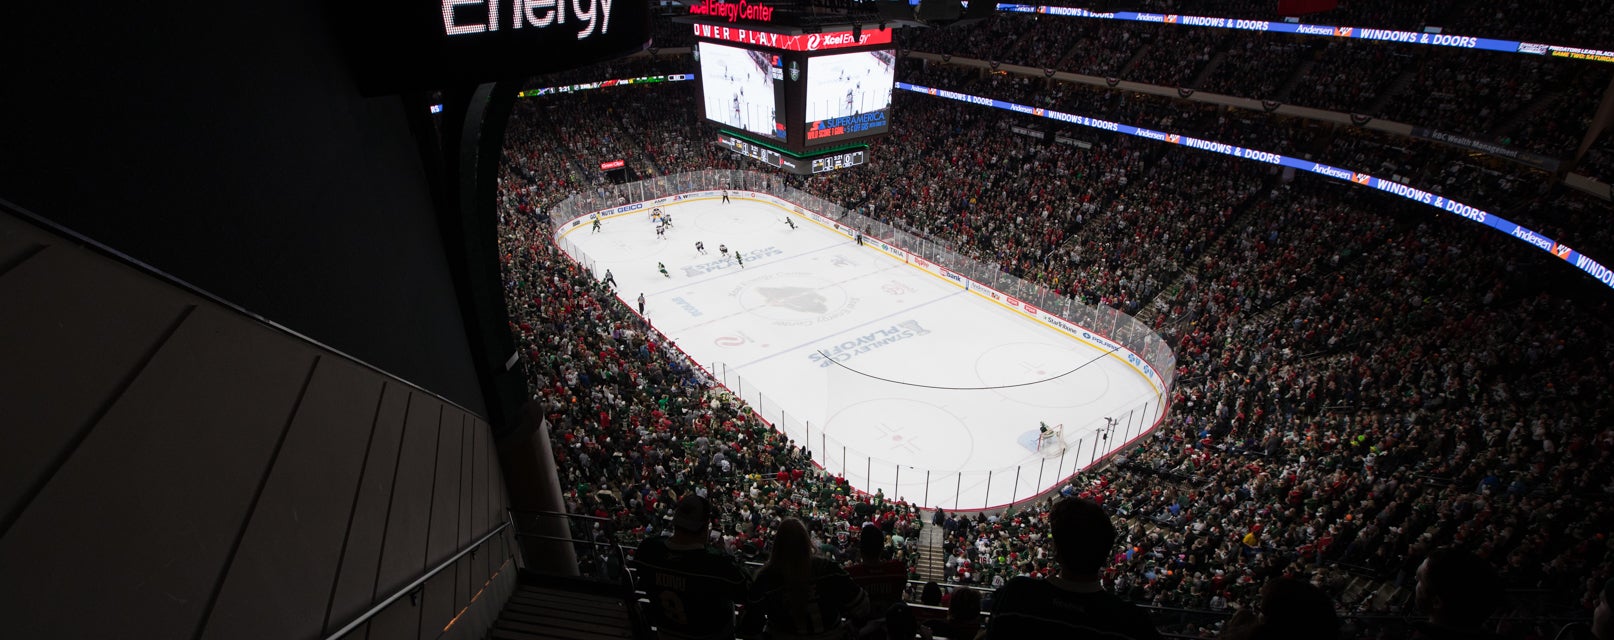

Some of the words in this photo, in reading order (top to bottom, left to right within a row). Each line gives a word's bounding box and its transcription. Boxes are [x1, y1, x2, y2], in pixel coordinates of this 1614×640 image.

[710, 0, 739, 22] Energy
[740, 0, 774, 21] Center
[1050, 6, 1082, 17] WINDOWS
[1136, 12, 1164, 23] Andersen
[1183, 15, 1226, 27] WINDOWS
[1227, 18, 1235, 27] &
[1236, 19, 1270, 31] DOORS
[694, 23, 730, 40] OWER
[739, 29, 778, 47] PLAY
[844, 32, 872, 44] Engy
[1296, 24, 1333, 35] Andersen
[1360, 29, 1418, 43] WINDOWS
[1420, 33, 1431, 44] &
[1433, 35, 1478, 48] DOORS
[939, 89, 967, 102] WINDOWS
[973, 96, 993, 107] DOORS
[827, 111, 885, 129] SUPERAMERICA
[1010, 102, 1034, 115] Andersen
[1048, 110, 1083, 125] WINDOWS
[1084, 117, 1091, 126] &
[1092, 119, 1119, 132] DOORS
[1135, 128, 1166, 141] Andersen
[1186, 137, 1232, 155] WINDOWS
[1234, 147, 1243, 157] &
[1244, 149, 1282, 165] DOORS
[1472, 139, 1519, 159] Management
[1311, 163, 1351, 181] Andersen
[1377, 178, 1433, 205] WINDOWS
[1434, 196, 1444, 209] &
[1445, 200, 1487, 224] DOORS
[617, 203, 643, 214] GEICO
[1511, 225, 1553, 251] Andersen
[946, 271, 961, 283] bank
[808, 326, 899, 362] PLAYOFFS
